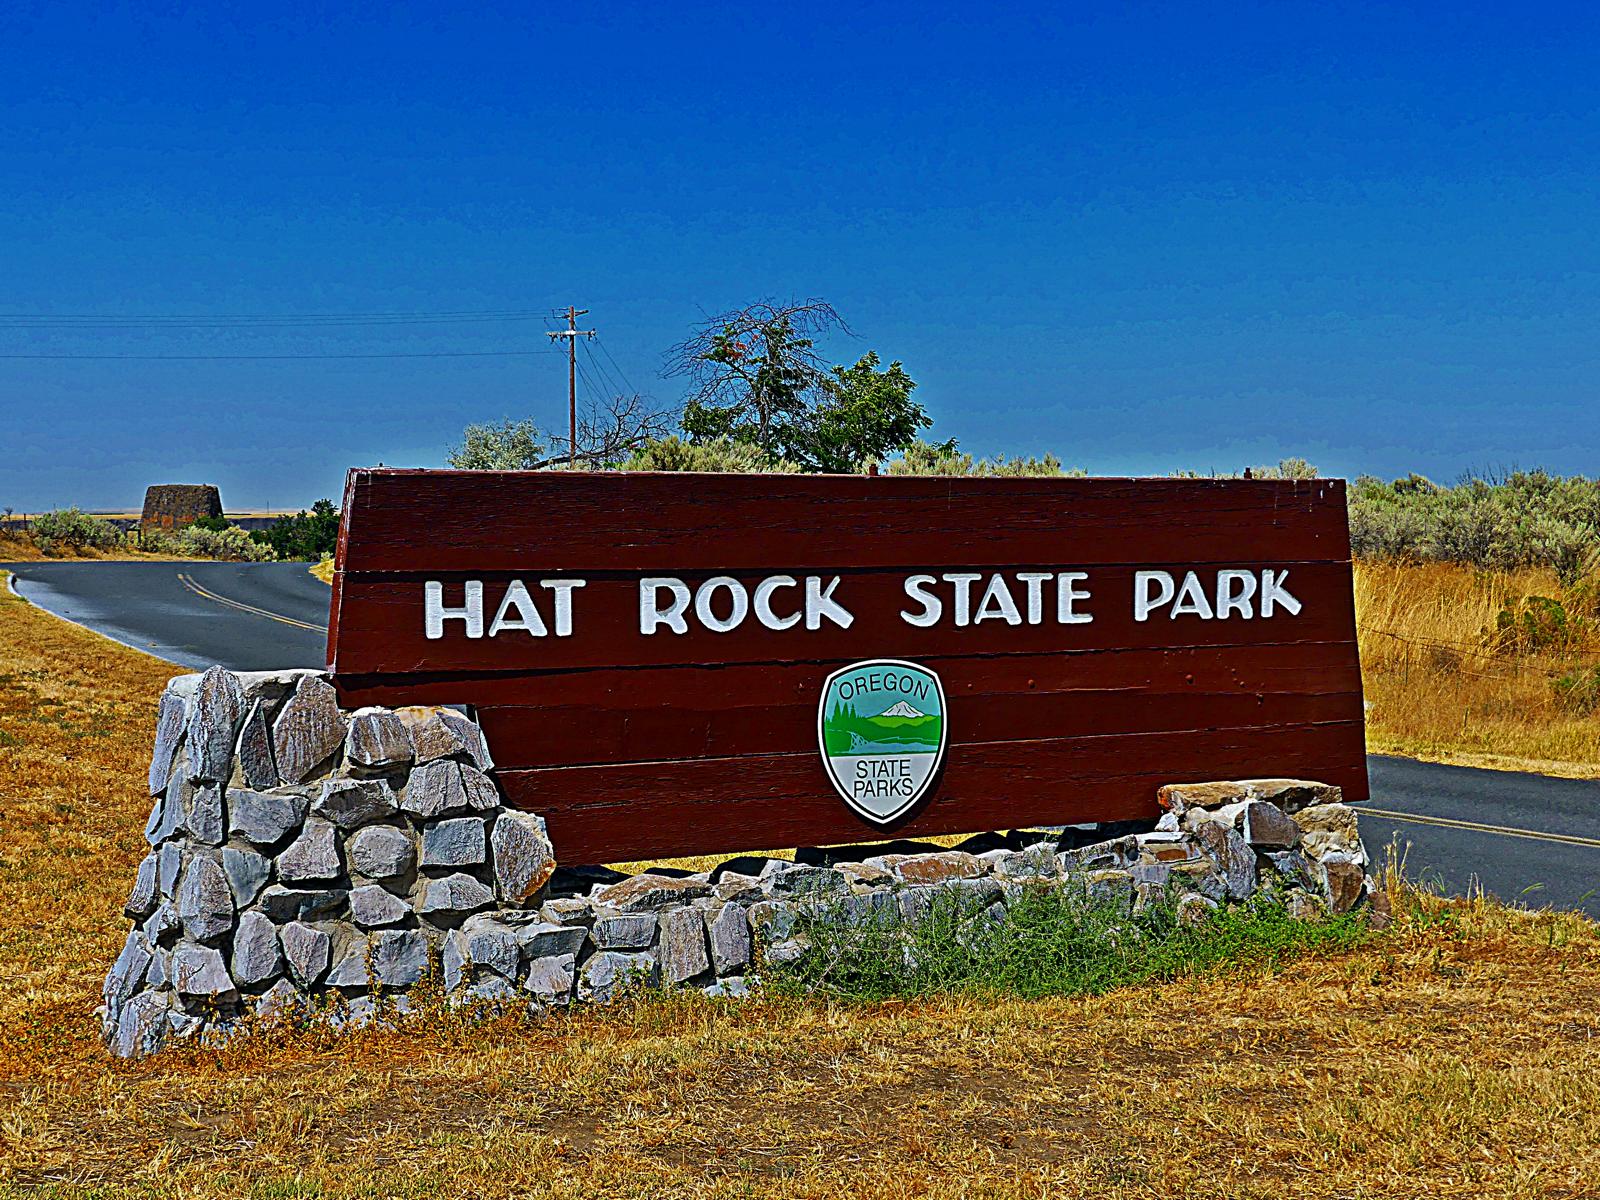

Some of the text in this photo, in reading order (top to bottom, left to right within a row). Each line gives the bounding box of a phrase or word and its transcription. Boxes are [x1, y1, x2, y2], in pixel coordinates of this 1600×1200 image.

[423, 569, 1302, 640] HAT ROCK STATE PARK
[839, 672, 929, 700] OREGON
[856, 759, 911, 779] STATE
[853, 778, 914, 798] PARKS
